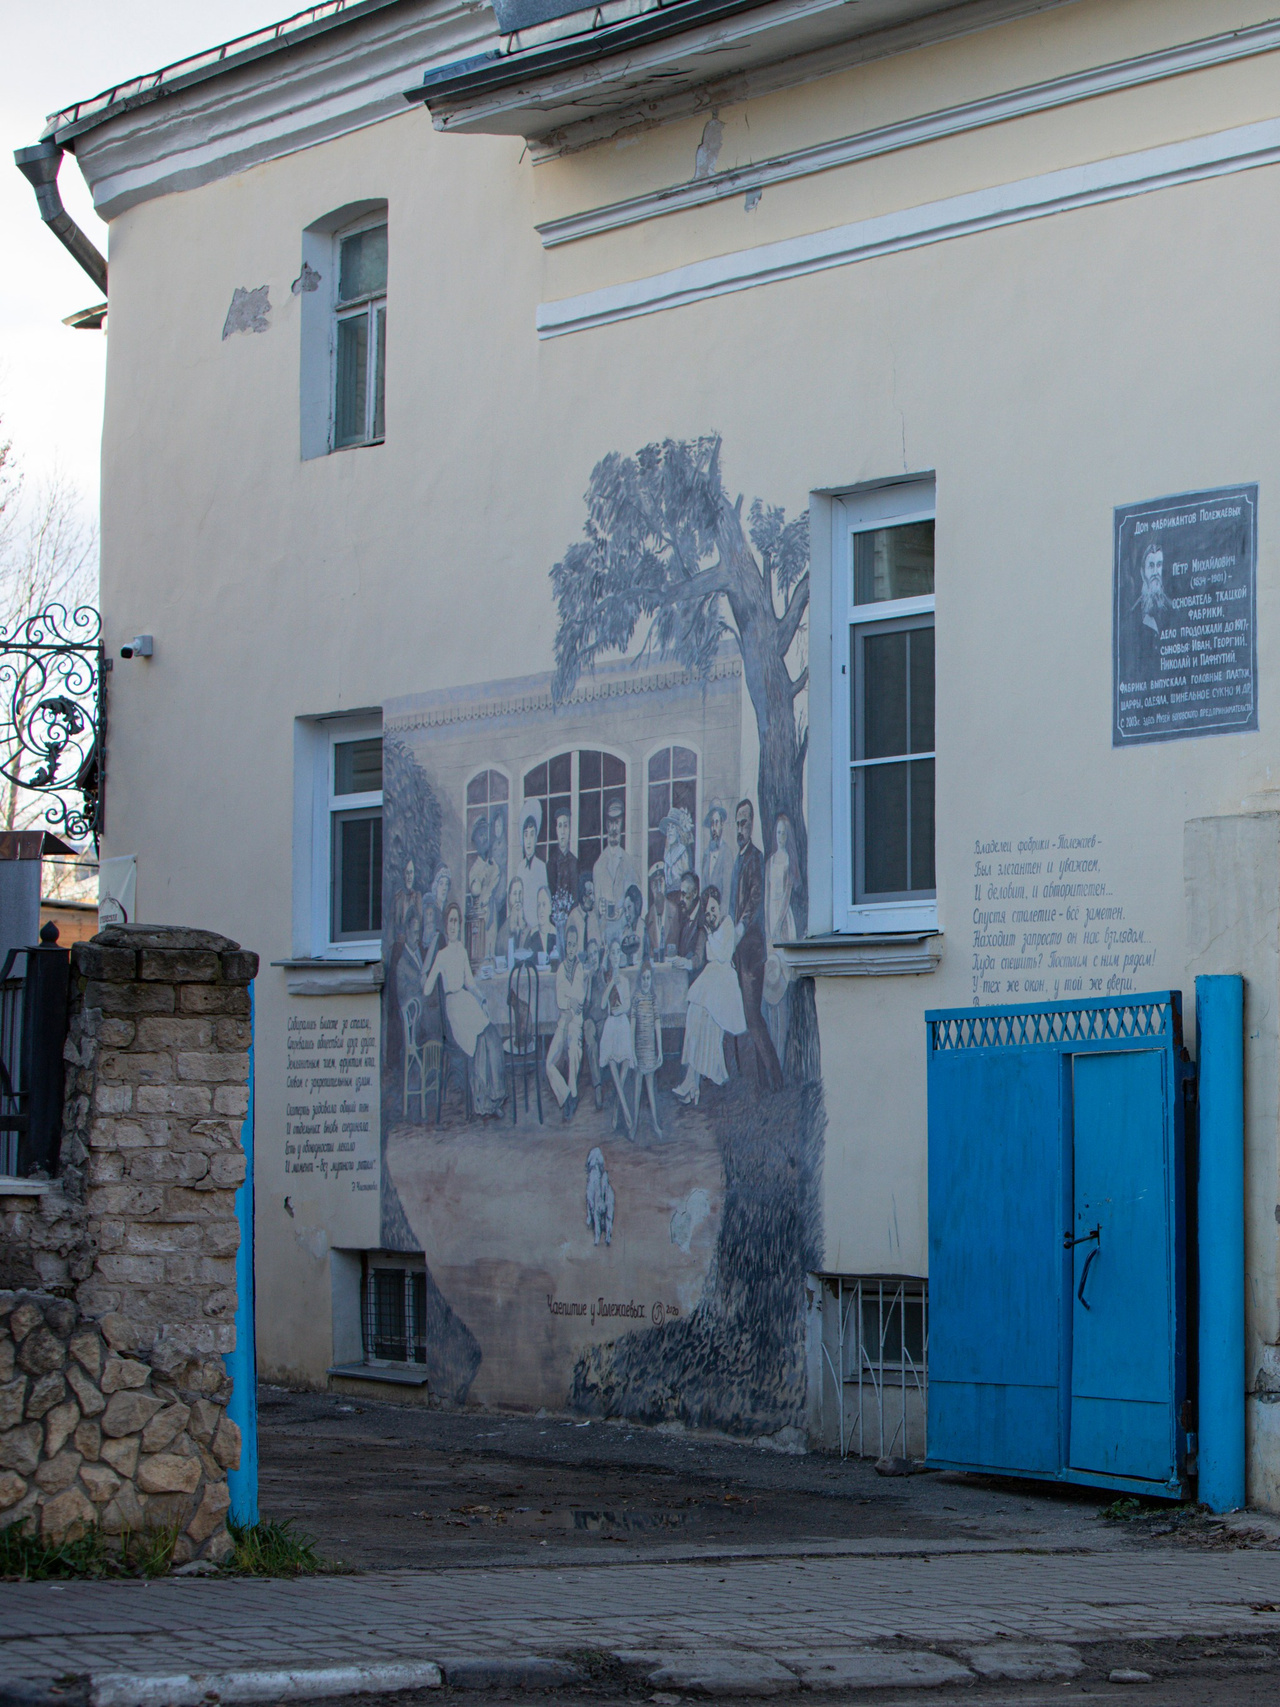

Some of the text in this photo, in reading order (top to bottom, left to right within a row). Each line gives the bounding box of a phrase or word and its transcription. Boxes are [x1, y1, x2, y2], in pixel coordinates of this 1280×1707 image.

[1151, 513, 1196, 530] ФАБРИКАНТОВ
[1200, 507, 1242, 521] ПОЛЕЖАЕВЫХ
[1192, 555, 1235, 572] МИХАЙЛОВИЧ
[1172, 586, 1247, 609] ОСНОВАТЕЛЬ ТКАЦКОЙ
[1160, 630, 1177, 640] ДЕЛО
[1180, 625, 1222, 637] ПРОДОЛЖАЛИ
[1224, 623, 1234, 633] ДО
[1160, 655, 1190, 670] НИКОЛАЙ
[1119, 682, 1147, 694] ФАБРИКА
[1151, 676, 1186, 689] ВЫПУСКАЛА
[1191, 670, 1222, 684] ГОЛОВНЫЕ
[1121, 699, 1143, 710] ШАРФЫ,
[1170, 689, 1210, 703] ШИНЕЛЬНОЕ
[1212, 686, 1234, 698] СУКНО
[1236, 685, 1240, 694] И
[1121, 718, 1124, 728] С
[974, 840, 1012, 854] Владелец
[1017, 837, 1049, 855] фабрики
[974, 861, 991, 877] Был
[998, 862, 1042, 876] элегантен
[1047, 864, 1053, 872] и
[975, 884, 981, 901] И
[1032, 886, 1038, 899] и
[973, 908, 1006, 931] Спустя
[1012, 908, 1056, 922] столетие
[1086, 906, 1125, 927] заметен.
[973, 930, 1015, 948] Находит
[1022, 932, 1062, 953] запросто
[1067, 934, 1077, 944] он
[1083, 933, 1100, 944] нас
[972, 948, 1156, 978] Куда спешить? Постоим с ним рядом!
[973, 976, 978, 992] У
[982, 980, 1001, 993] тех
[1006, 980, 1019, 992] же
[1054, 979, 1060, 999] у
[1064, 976, 1082, 990] той
[1089, 978, 1102, 991] же
[1106, 973, 1137, 996] двери,
[288, 1017, 316, 1034] Собирались
[320, 1016, 339, 1029] вместе
[342, 1019, 348, 1035] за
[305, 1079, 308, 1087] с
[286, 1122, 291, 1135] И
[297, 1145, 301, 1159] у
[285, 1160, 290, 1173] И
[547, 1294, 586, 1316] Чаепитие
[591, 1304, 595, 1326] у
[666, 1305, 679, 1316] 2020
